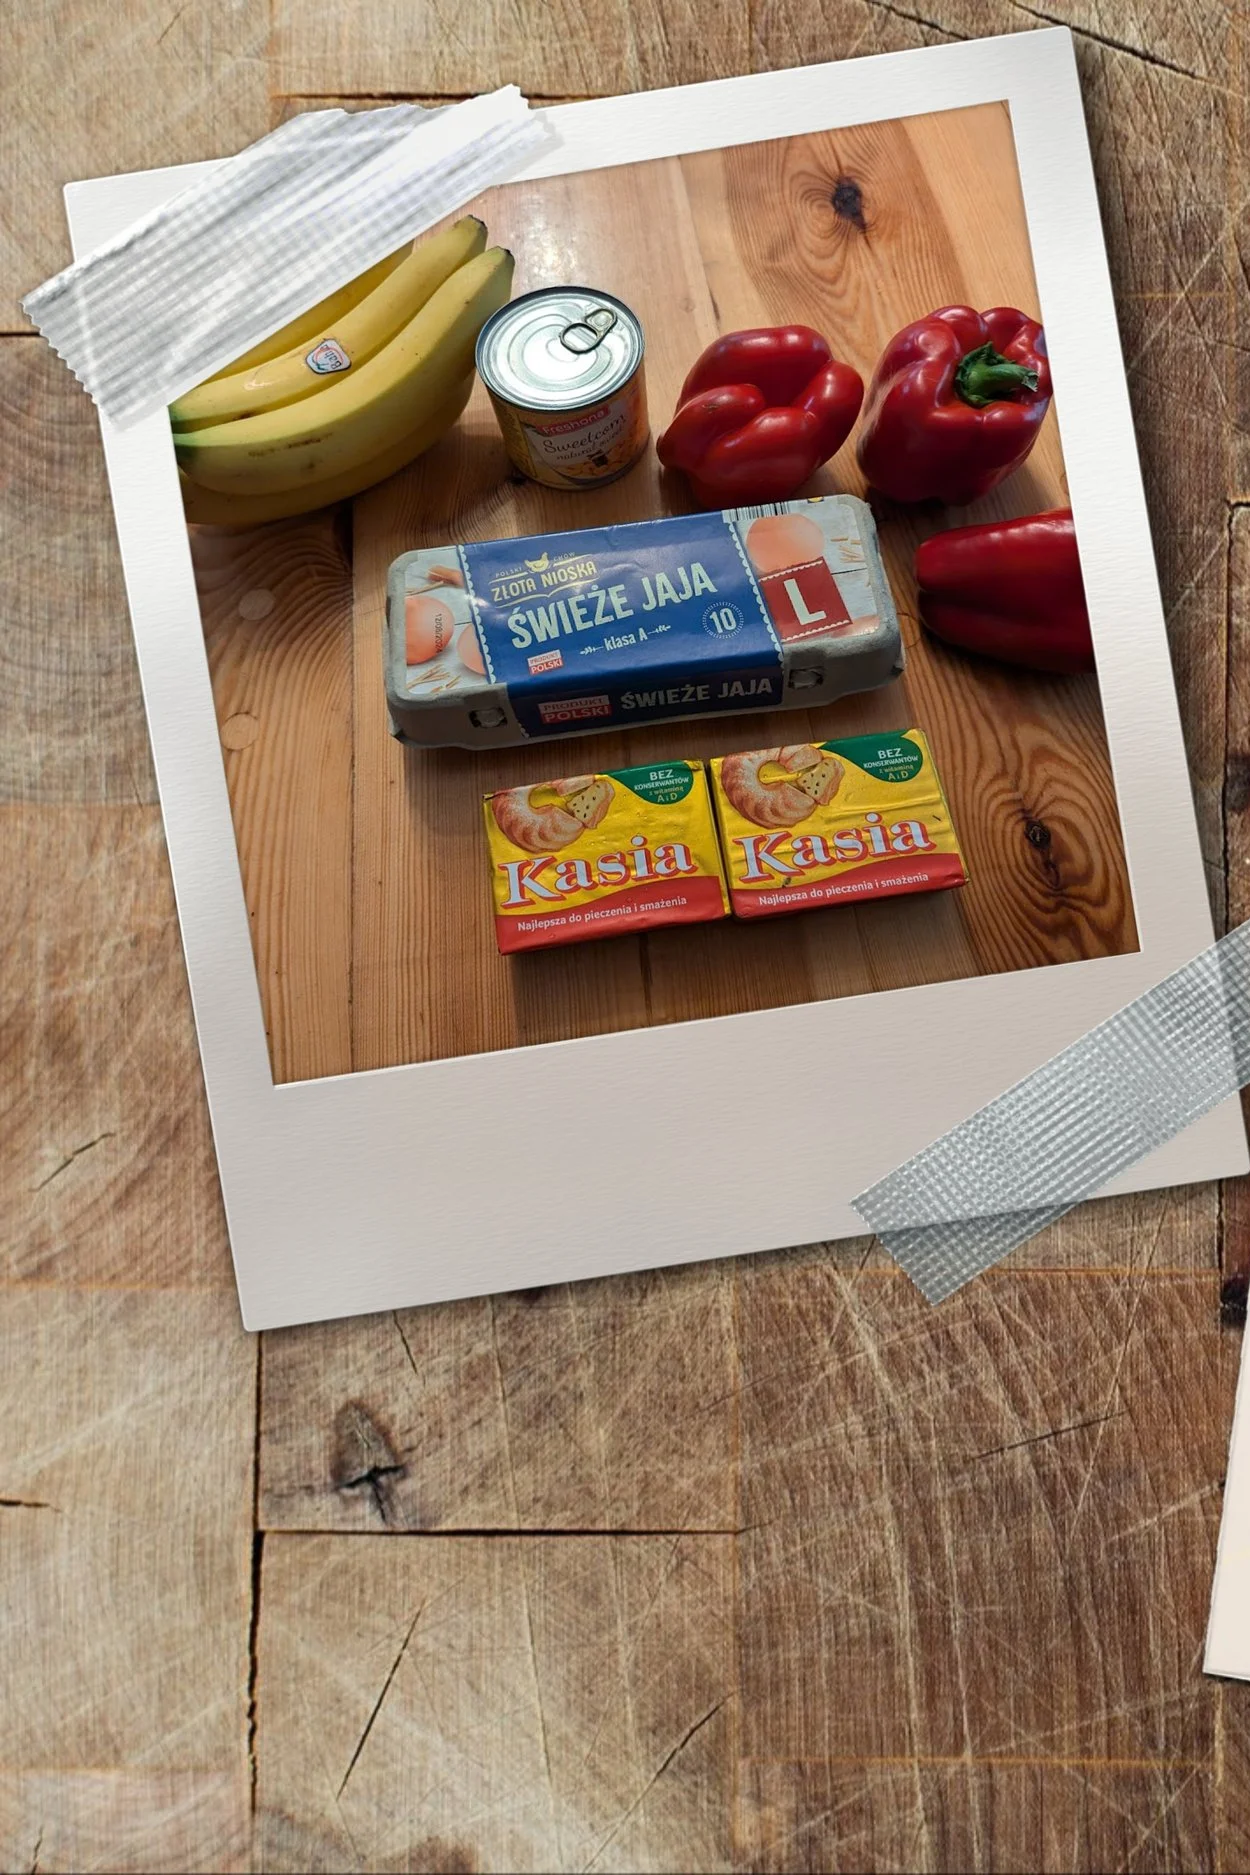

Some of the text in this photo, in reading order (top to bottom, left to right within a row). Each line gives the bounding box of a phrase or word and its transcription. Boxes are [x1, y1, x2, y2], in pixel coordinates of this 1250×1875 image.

[541, 410, 605, 434] Freshona
[491, 561, 598, 602] ZŁOTA NIOSKA
[507, 562, 718, 649] ŚWIEŻE JAJA
[783, 578, 827, 626] L
[709, 607, 737, 634] 10
[604, 628, 648, 651] klasa A
[531, 658, 563, 674] POLSKI
[543, 698, 605, 711] PRODUKT
[621, 678, 772, 710] ŚWIEŻE JAJA
[544, 705, 609, 723] POLSKI
[863, 755, 919, 769] KONSERWANTÓW
[877, 748, 903, 760] BEZ
[634, 777, 690, 791] KONSERWANTÓW
[649, 769, 674, 781] BEZ
[888, 772, 896, 781] A
[900, 770, 909, 779] D
[657, 794, 665, 802] A
[670, 792, 678, 801] D
[733, 812, 937, 884] Kasia
[499, 835, 698, 910] Kasia
[759, 890, 808, 906] Najlepsza
[810, 887, 824, 898] do
[825, 880, 873, 898] pieczenia
[881, 872, 929, 888] smażenia
[517, 916, 567, 932] Najlepsza
[569, 913, 583, 924] do
[584, 906, 632, 923] pieczenia
[640, 895, 687, 912] smażenia
